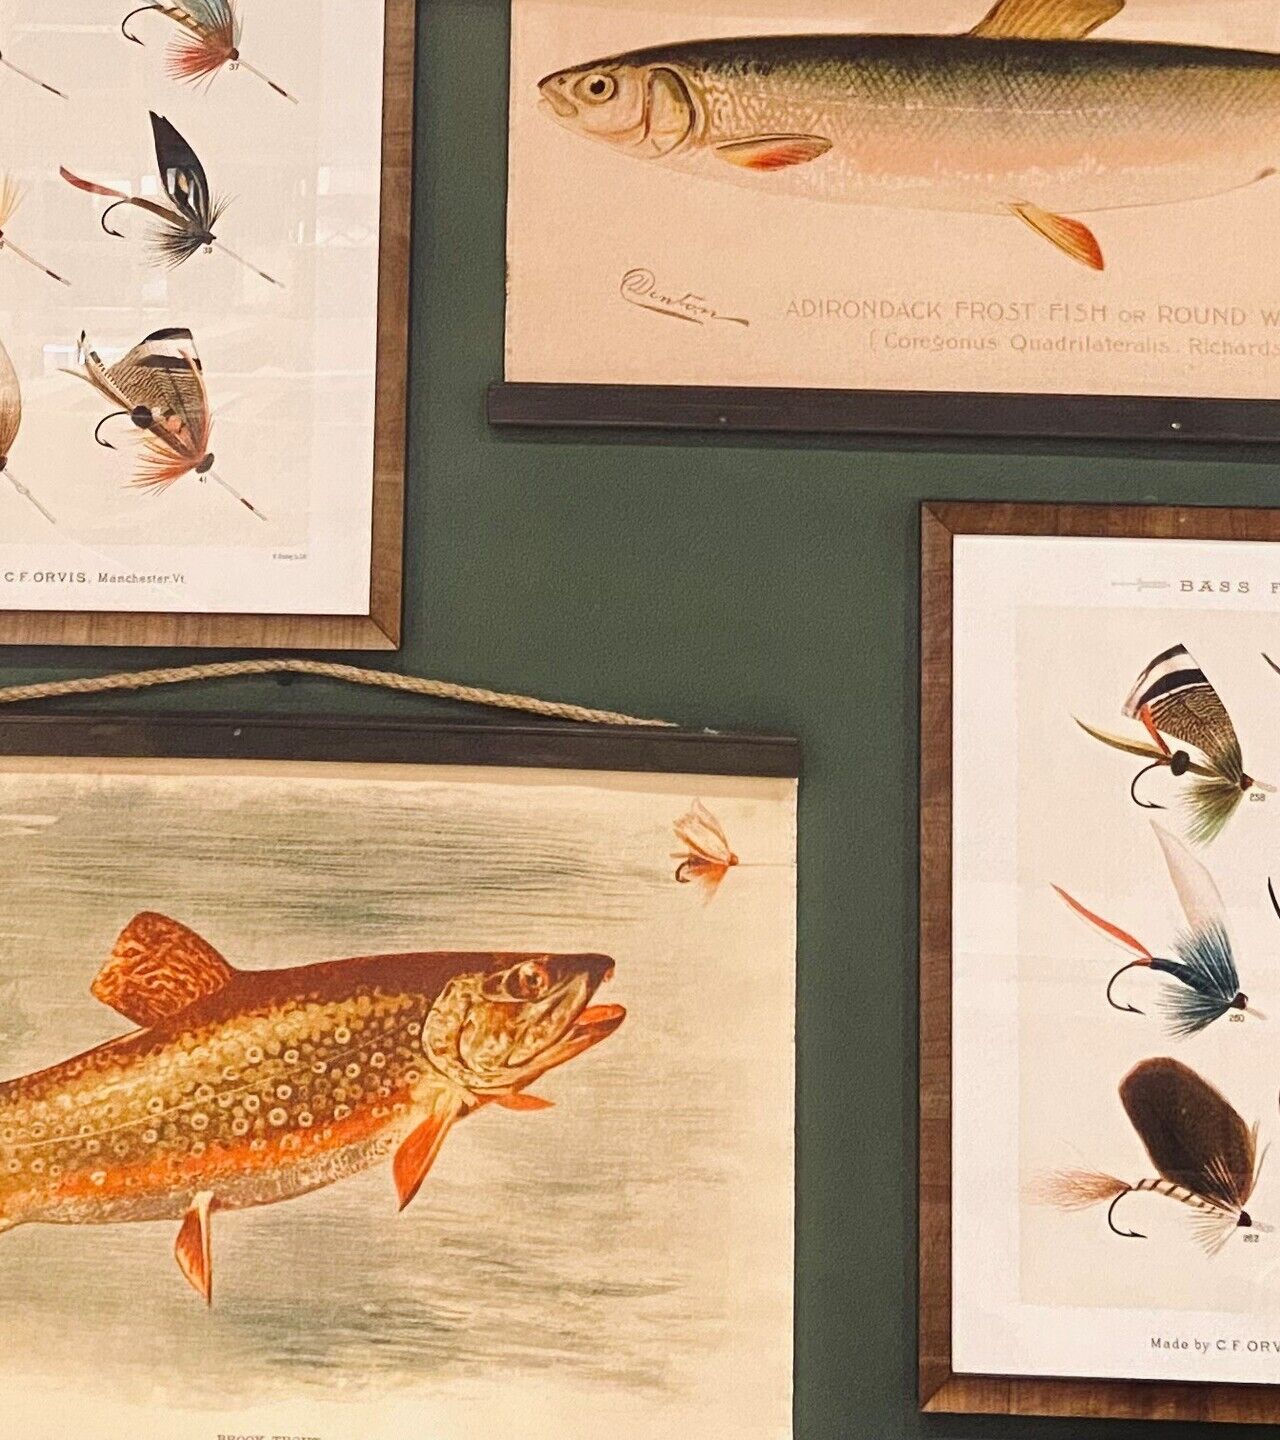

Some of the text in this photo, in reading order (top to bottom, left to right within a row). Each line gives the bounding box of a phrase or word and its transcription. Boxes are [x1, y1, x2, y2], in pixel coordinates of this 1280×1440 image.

[228, 63, 240, 71] 37
[785, 299, 943, 321] ADIRONDACK
[954, 301, 1035, 322] FROST
[1048, 303, 1108, 323] FISH
[1156, 304, 1248, 327] ROUND
[1179, 579, 1250, 593] BASS
[1150, 1337, 1189, 1350] Made
[1194, 1338, 1210, 1353] by
